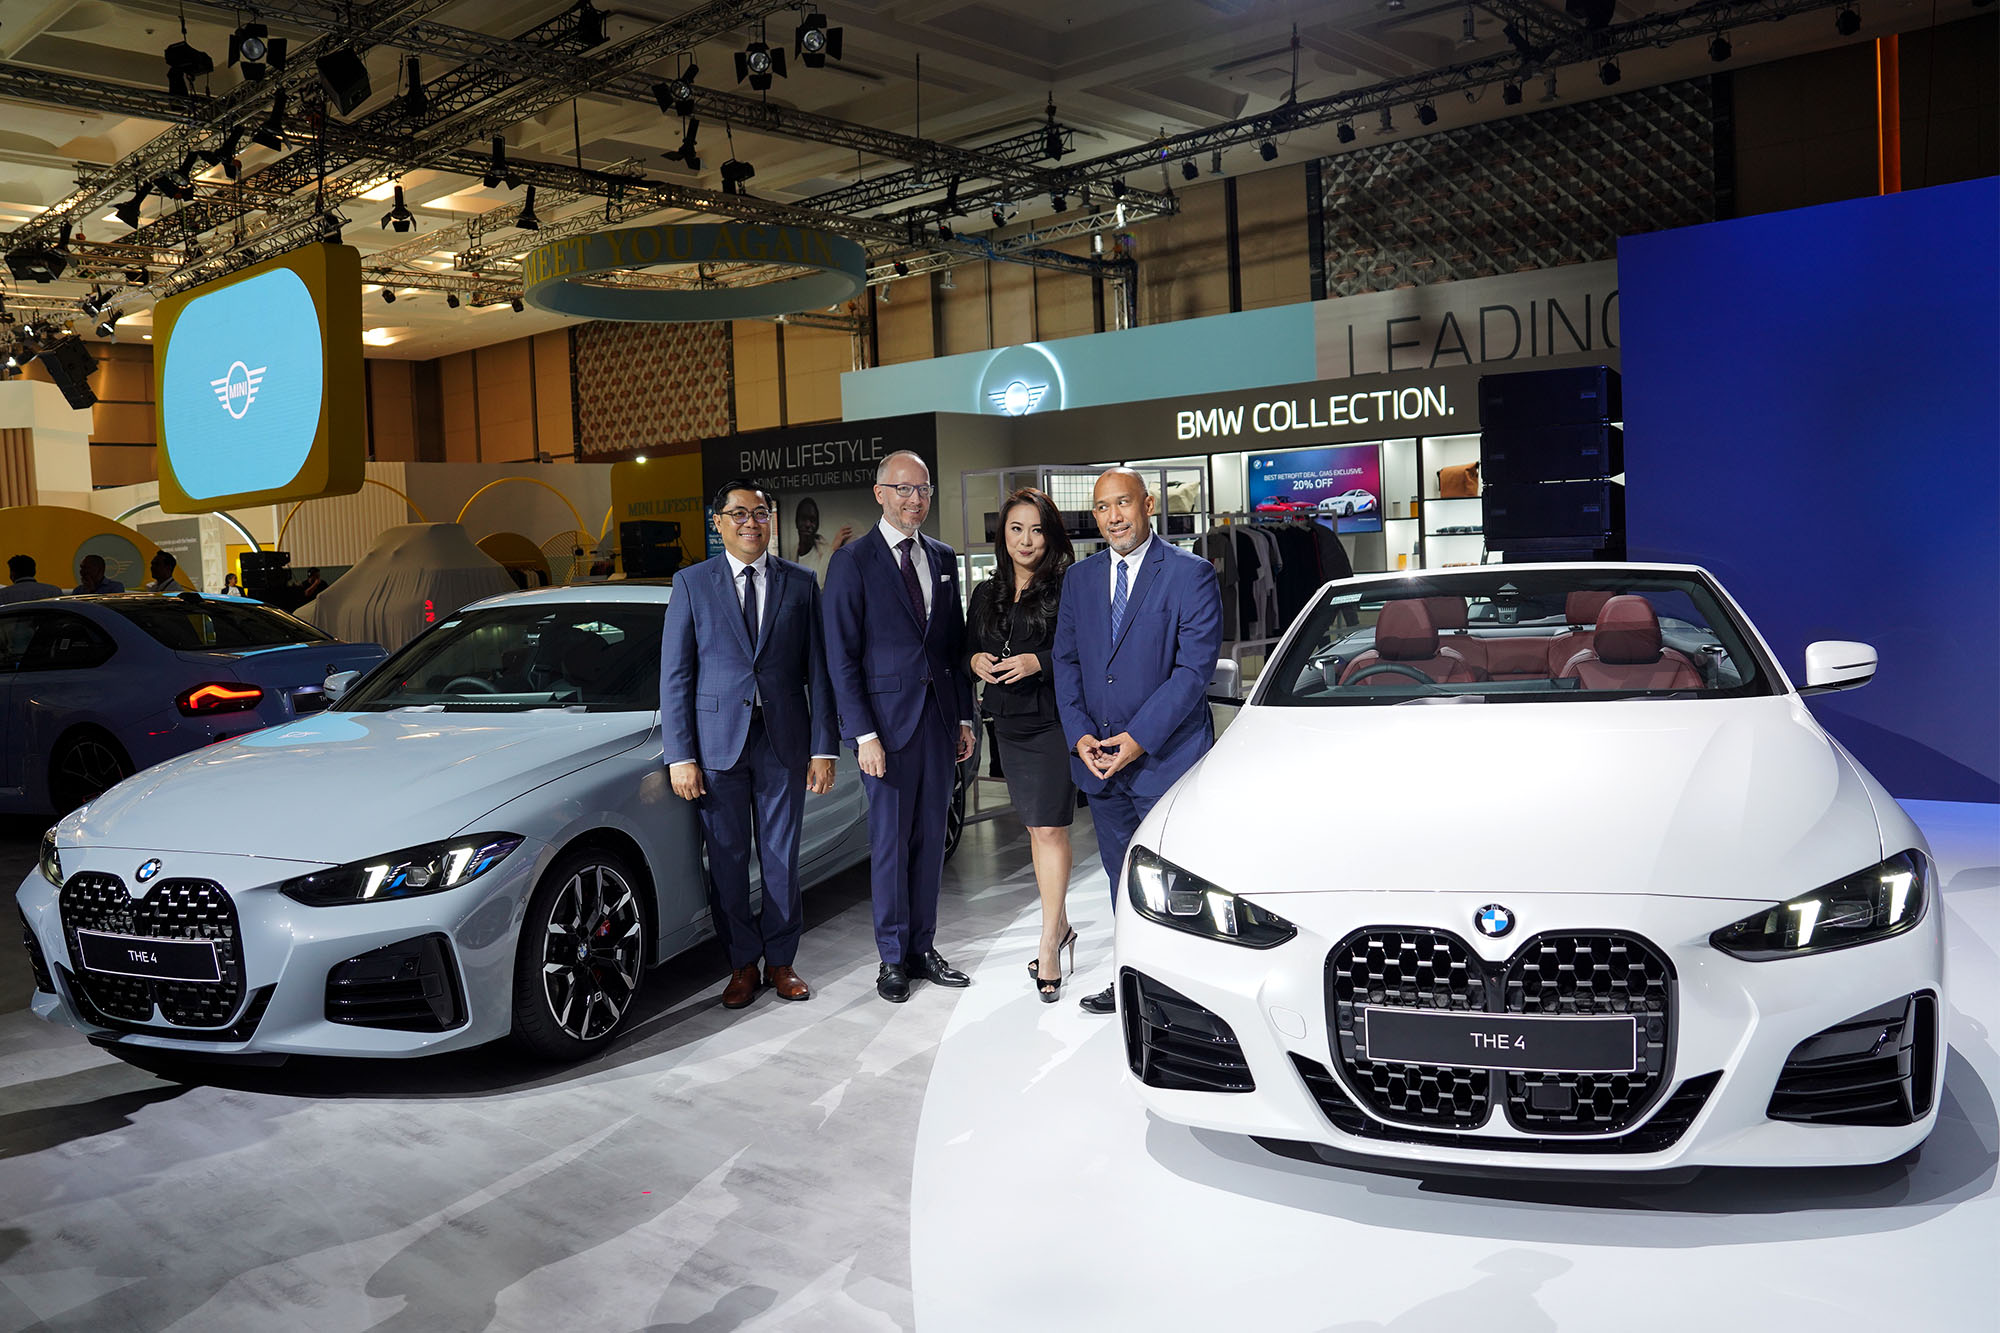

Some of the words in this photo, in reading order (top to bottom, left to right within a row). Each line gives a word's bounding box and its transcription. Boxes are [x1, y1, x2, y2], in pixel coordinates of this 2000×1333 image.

[523, 235, 591, 286] MEET
[602, 224, 694, 267] YOU
[706, 224, 841, 267] AGAIN.
[229, 380, 248, 399] MINI
[1176, 405, 1244, 440] BMW
[1252, 385, 1455, 434] COLLECTION.
[740, 447, 782, 473] BMW
[781, 474, 800, 488] THE
[802, 471, 840, 487] FUTURE
[842, 470, 853, 483] IN
[854, 468, 878, 483] STYL
[1263, 473, 1277, 481] BEST
[1278, 471, 1303, 480] RETROFIT
[1292, 479, 1313, 491] 20%
[1314, 477, 1334, 489] OFF
[628, 501, 654, 518] MINI
[655, 496, 704, 516] LIFESTY
[127, 949, 149, 962] THE
[150, 952, 158, 964] 4
[1469, 1031, 1510, 1050] THE
[1513, 1034, 1526, 1050] 4
